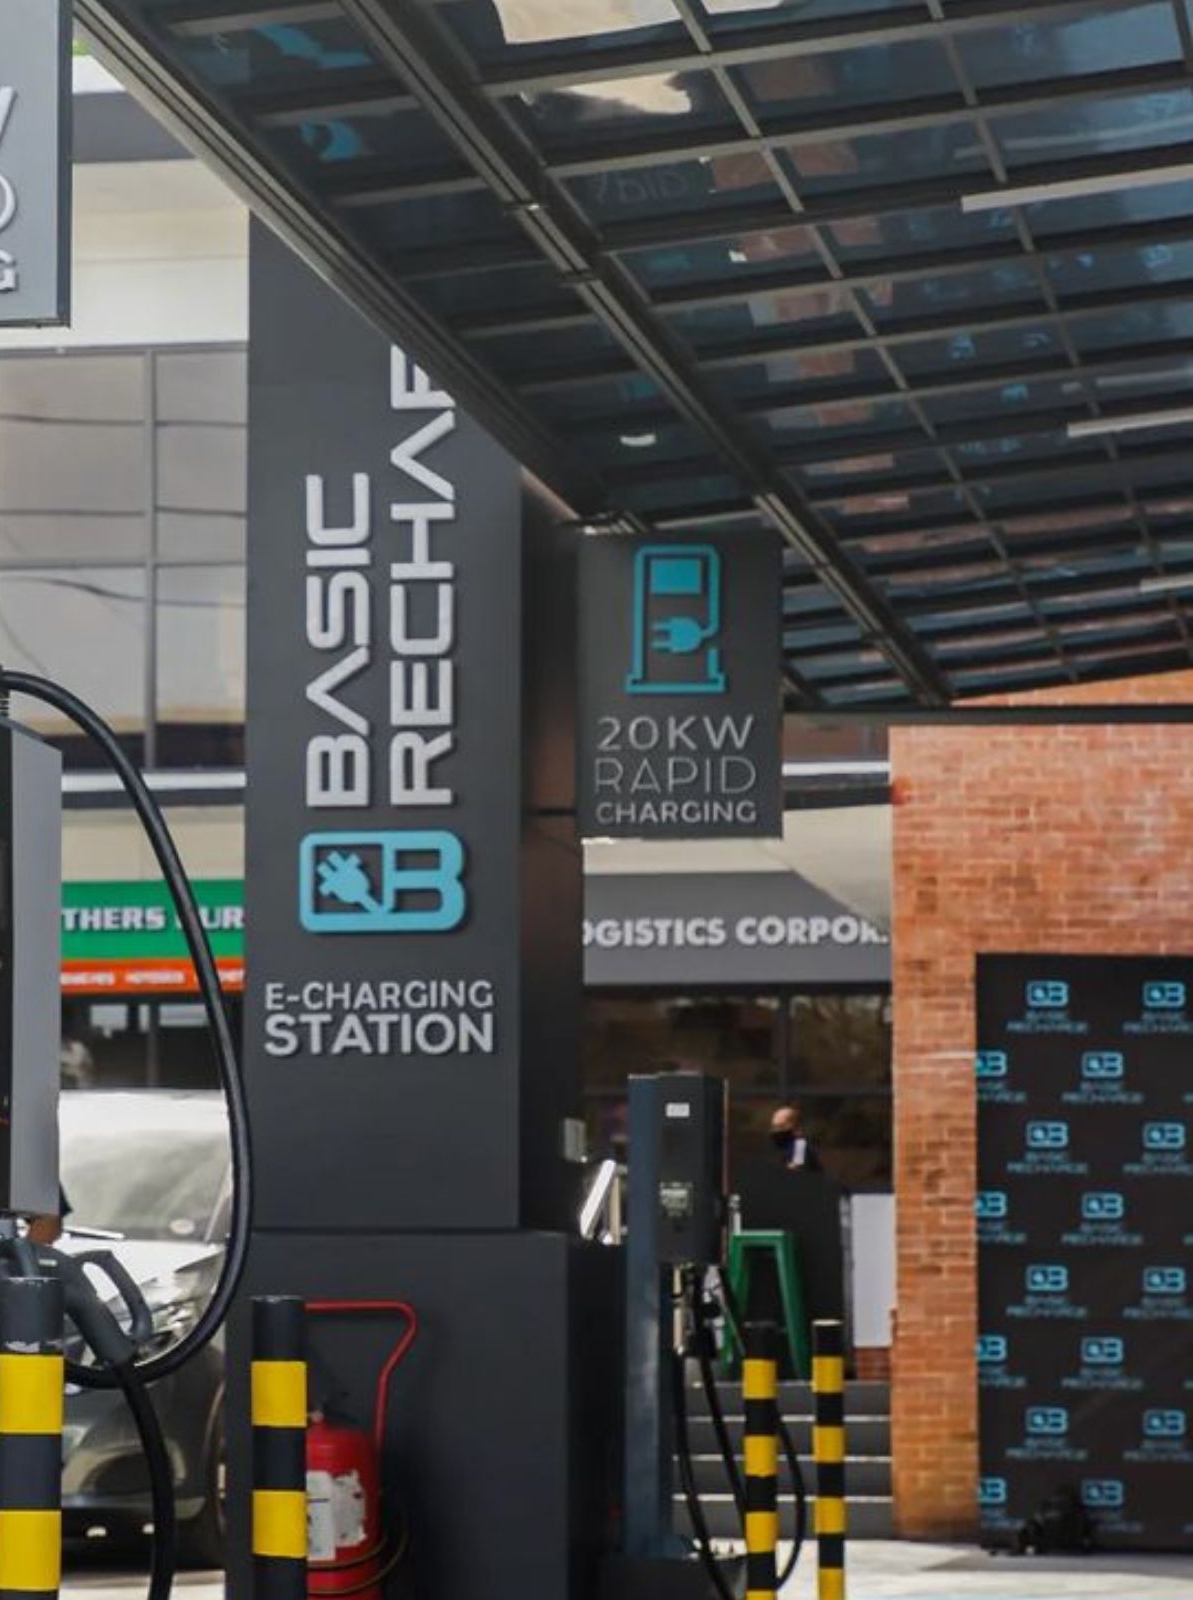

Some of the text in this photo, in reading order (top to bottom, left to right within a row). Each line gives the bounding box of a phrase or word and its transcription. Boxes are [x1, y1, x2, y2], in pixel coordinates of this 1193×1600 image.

[306, 472, 370, 807] BASIC
[598, 714, 753, 750] 20KW
[595, 756, 756, 794] RAPID
[596, 801, 756, 823] CHARGING
[175, 905, 244, 929] UR
[265, 980, 494, 1010] E-CHARGING
[264, 1013, 494, 1056] STATION
